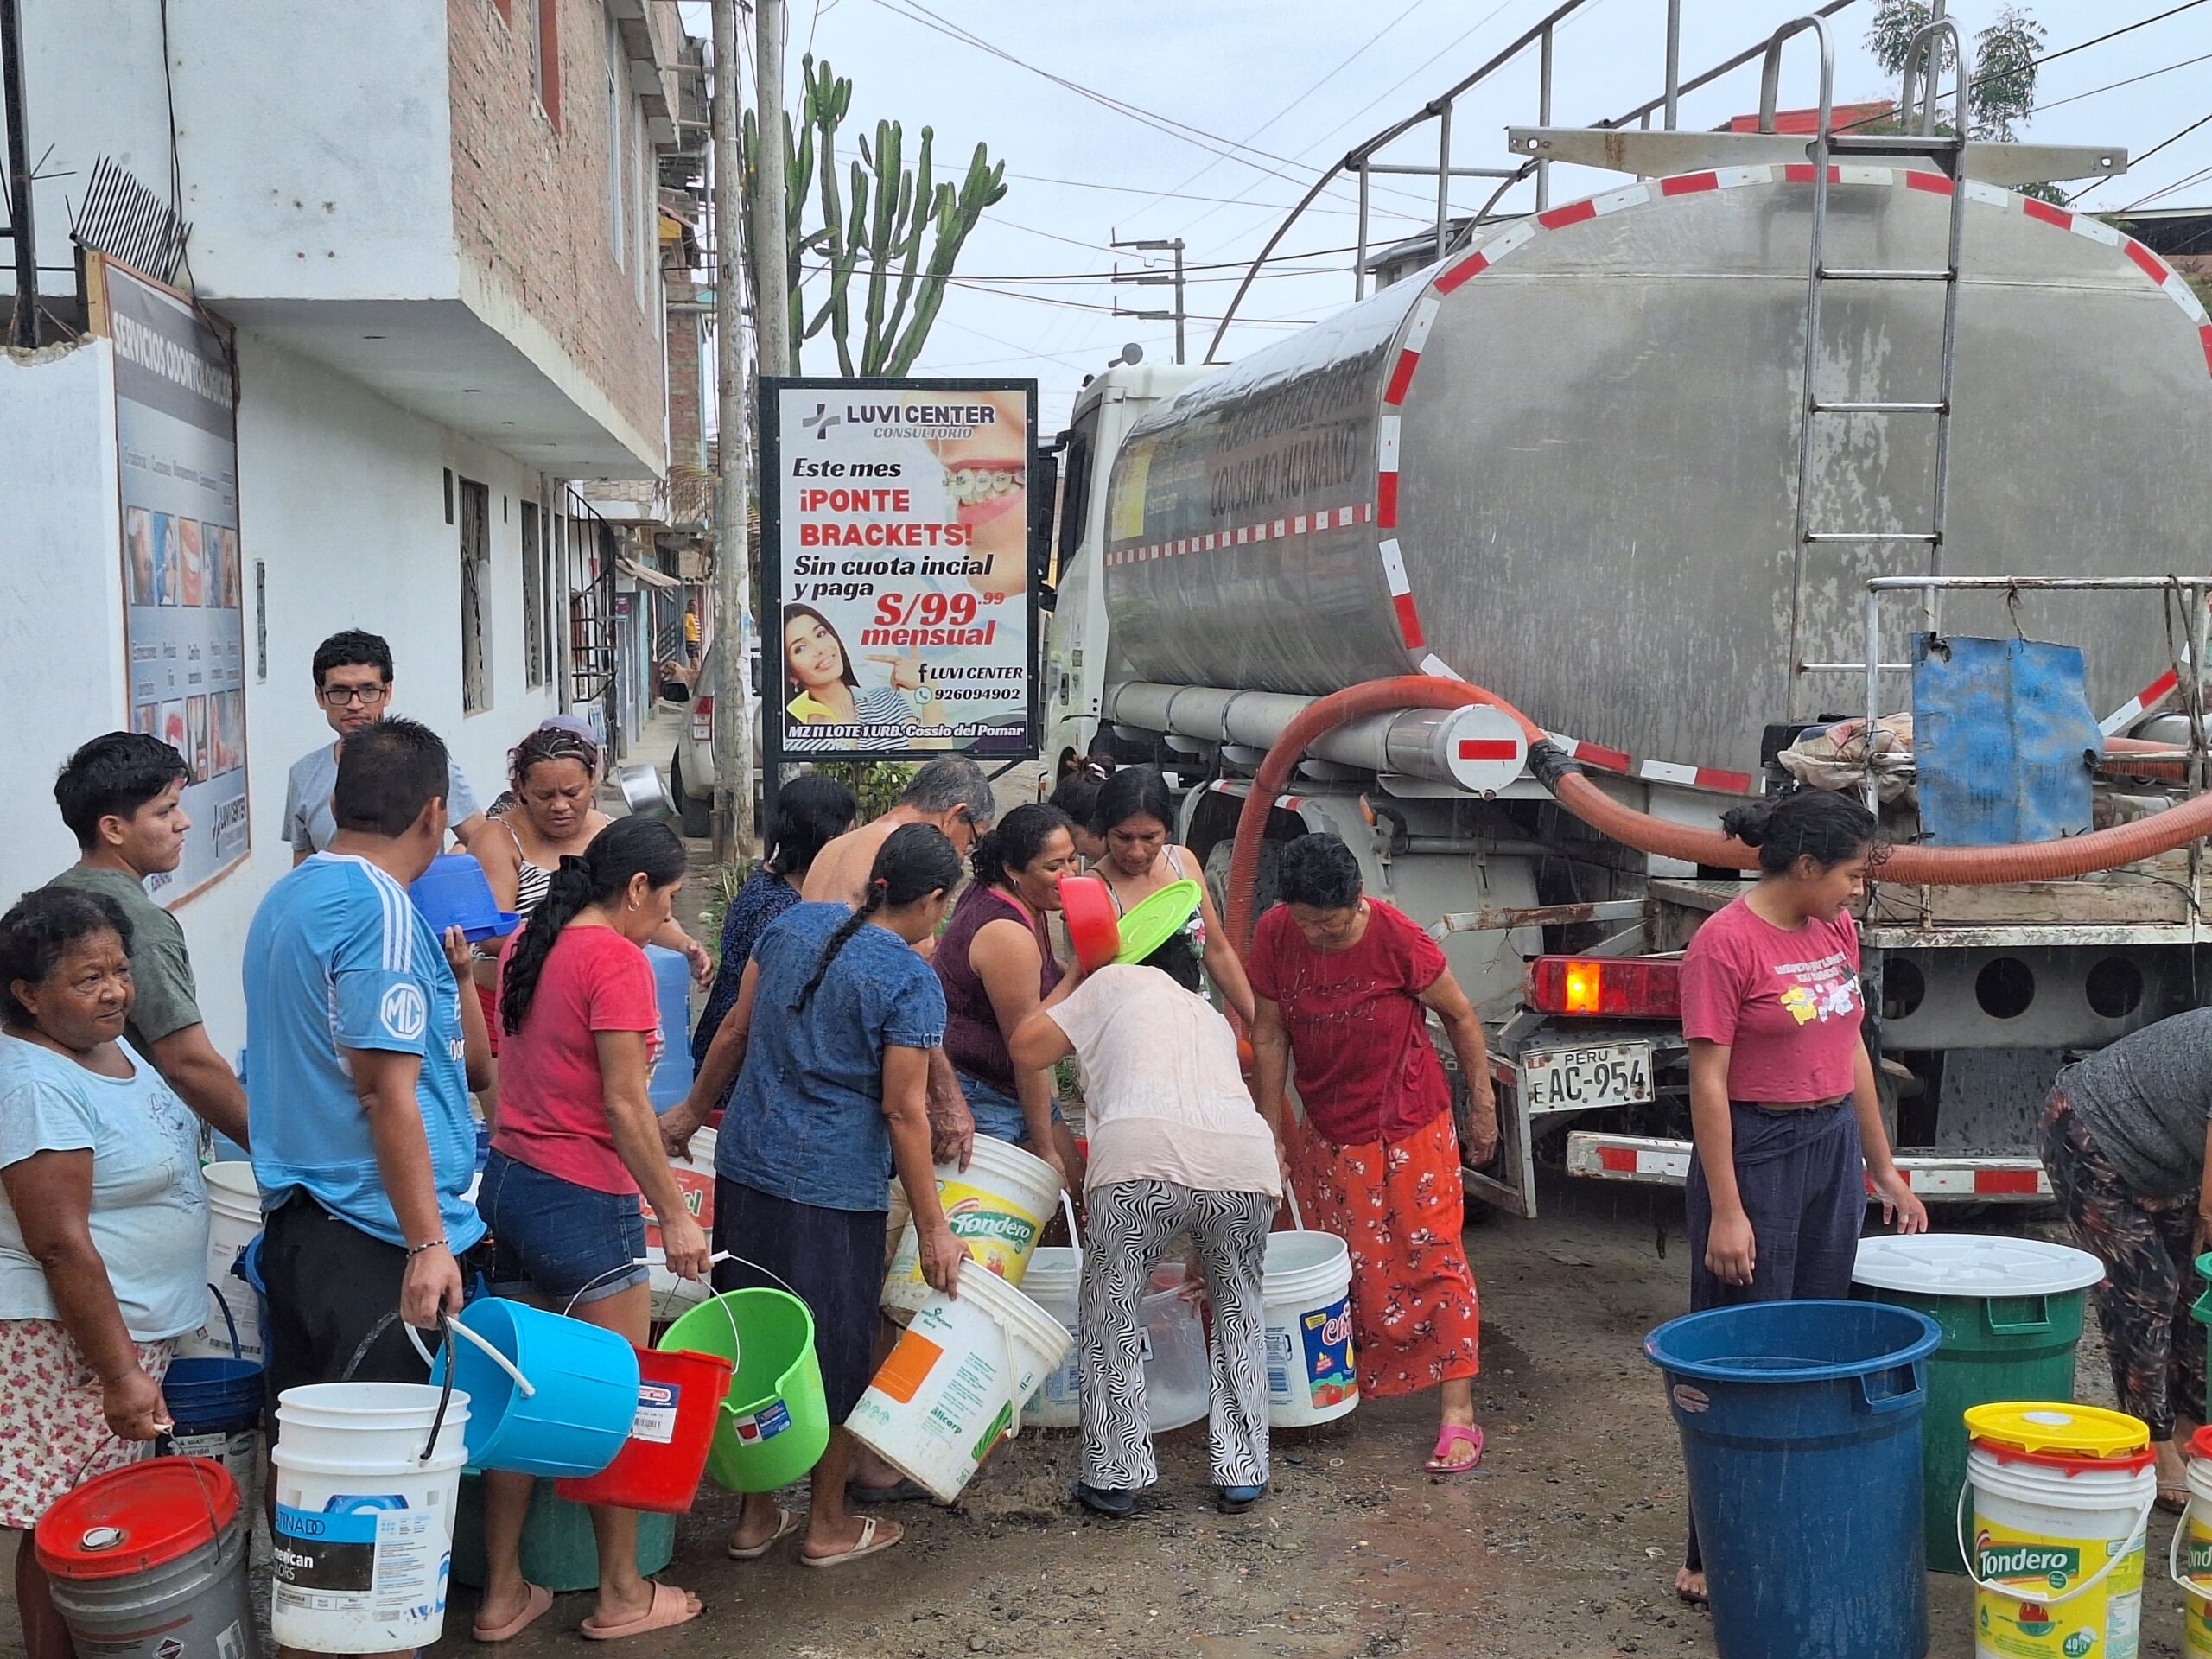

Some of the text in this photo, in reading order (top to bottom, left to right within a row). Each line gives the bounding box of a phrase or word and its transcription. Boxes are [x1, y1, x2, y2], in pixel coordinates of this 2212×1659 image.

[113, 311, 166, 377] SERVICIOS
[847, 405, 995, 424] LUVI CENTER
[873, 427, 973, 439] CONSULTORIO
[793, 458, 901, 477] Este mes
[1211, 423, 1358, 517] CONSUMO HUMANO
[800, 524, 974, 547] BRACKETS!
[794, 555, 995, 575] Sin cuota incial
[792, 582, 874, 601] y paga
[861, 620, 996, 645] mensual
[930, 667, 964, 679] LUVI
[966, 667, 1023, 679] CENTER
[934, 689, 1020, 701] 926094902
[788, 726, 812, 738] MZ
[825, 726, 861, 737] LOTE
[870, 726, 903, 737] URB.
[906, 725, 953, 737] Cossio
[954, 724, 976, 736] del
[978, 725, 1025, 737] Pomar
[385, 990, 424, 1036] MG
[1565, 1050, 1609, 1065] PERU
[930, 1407, 963, 1434] alicorp
[1980, 1548, 2068, 1578] Tondero
